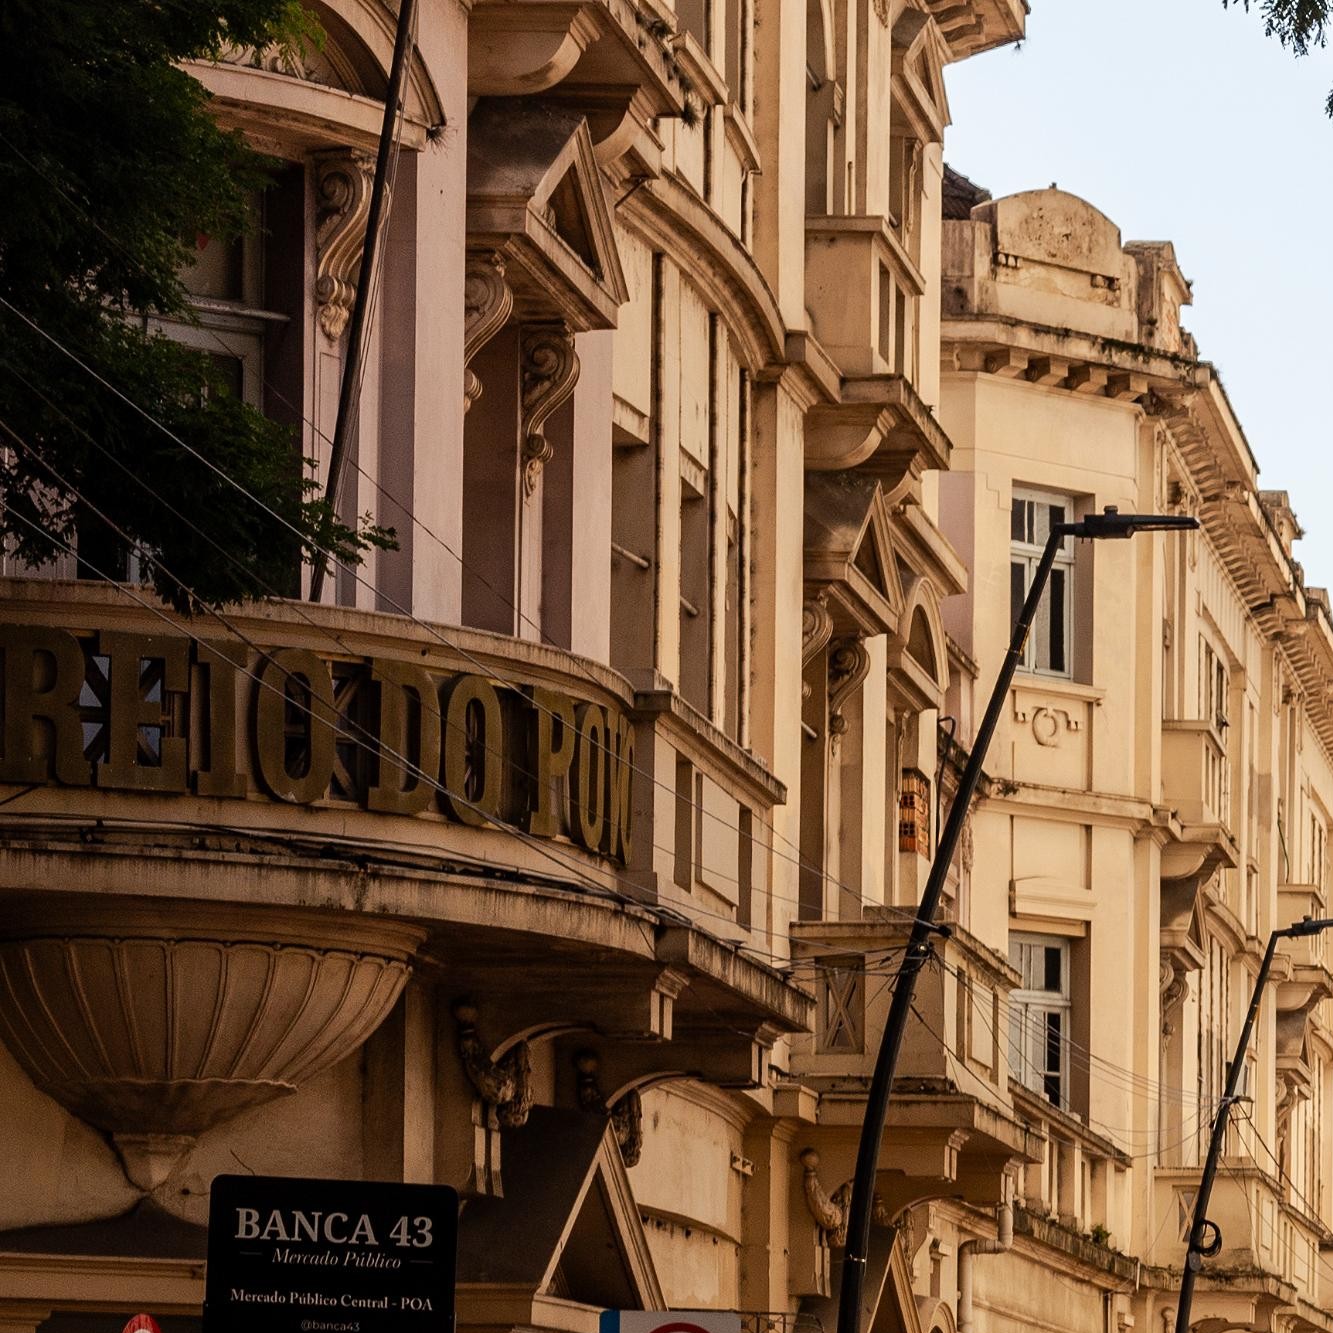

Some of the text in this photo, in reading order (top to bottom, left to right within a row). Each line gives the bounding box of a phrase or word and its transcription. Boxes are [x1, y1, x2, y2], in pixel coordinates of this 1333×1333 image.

[368, 657, 502, 827] DO
[235, 1208, 433, 1248] BANCA 43
[272, 1248, 402, 1269] Mercado Público
[231, 1289, 286, 1304] Mercado
[290, 1291, 337, 1307] Público
[340, 1295, 388, 1309] Central
[400, 1298, 433, 1311] POA
[301, 1319, 361, 1332] @banca43
